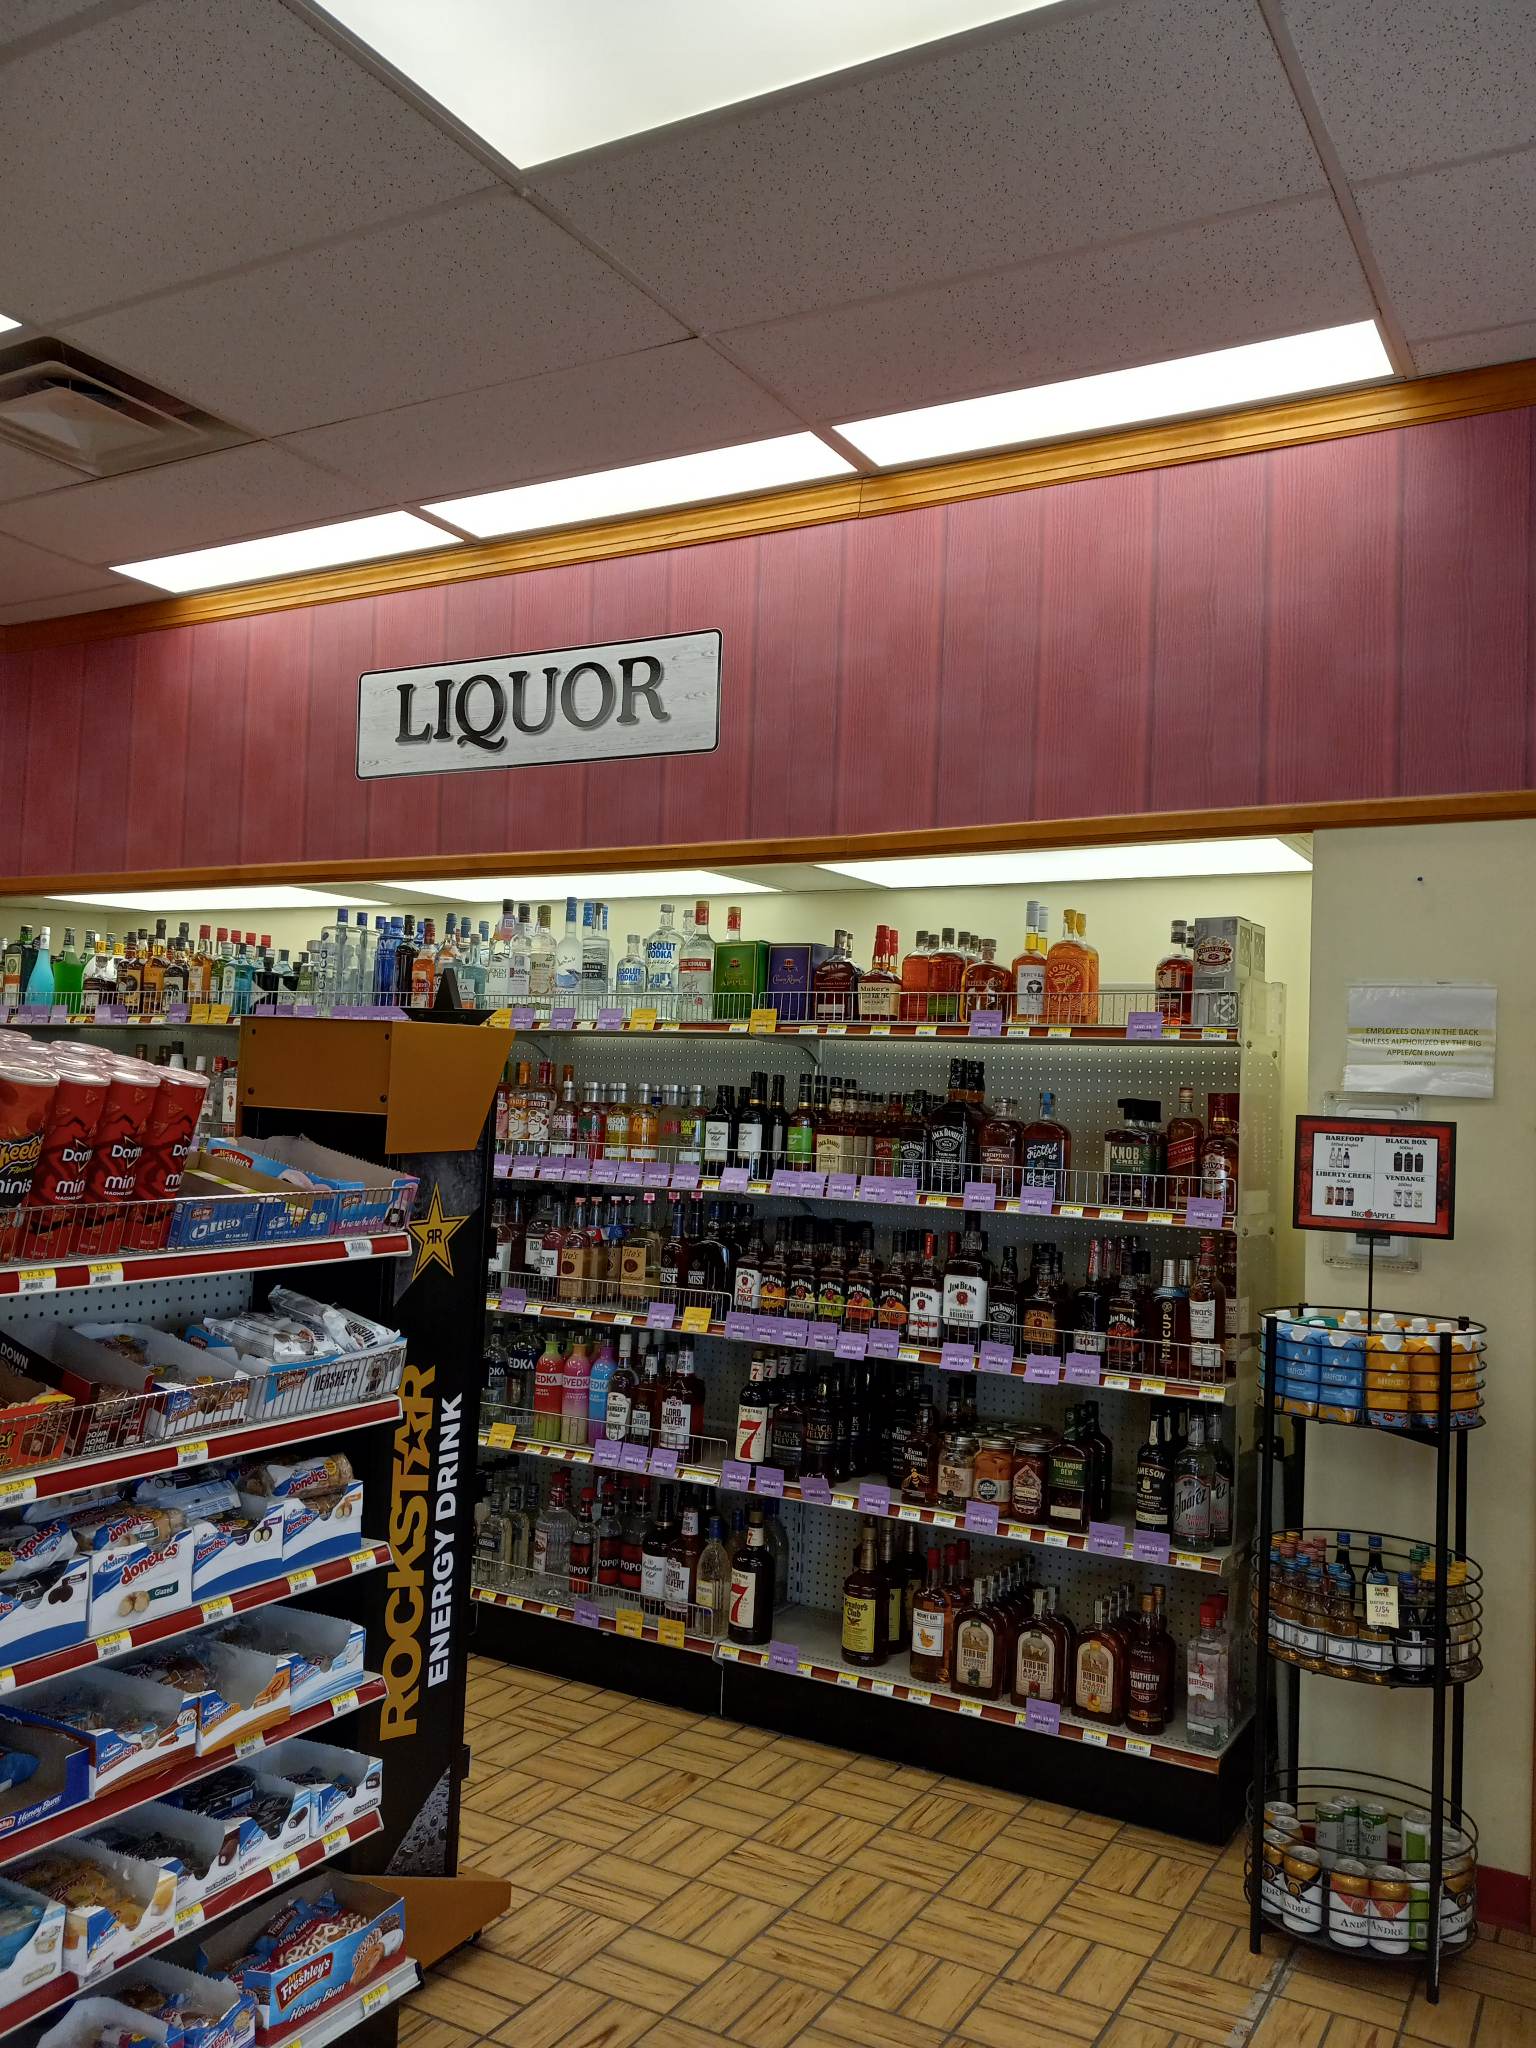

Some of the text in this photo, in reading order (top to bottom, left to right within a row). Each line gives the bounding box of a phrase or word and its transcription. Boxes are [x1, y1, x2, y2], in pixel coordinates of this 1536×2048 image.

[394, 655, 669, 751] LIQUOR
[1048, 962, 1082, 978] HOWLER
[1391, 1038, 1439, 1046] AUTHORIZED
[931, 1127, 944, 1141] JACK
[1111, 1146, 1140, 1160] KNOB
[190, 1218, 241, 1240] OREO
[623, 1248, 642, 1258] Tito's
[687, 1276, 705, 1286] MIST
[828, 1281, 842, 1293] BEAM
[889, 1287, 904, 1300] BEAM
[948, 1281, 977, 1296] JIM BEAM
[0, 1343, 29, 1368] DOWN
[751, 1367, 760, 1380] 7
[765, 1365, 773, 1377] 7
[313, 1367, 360, 1392] HERSHEY'S
[665, 1407, 681, 1417] LORD
[85, 1437, 107, 1445] HOME
[87, 1430, 109, 1439] DOWN
[739, 1420, 762, 1460] 7
[82, 1442, 117, 1454] DELIGHTS
[907, 1447, 923, 1456] Evan
[1053, 1458, 1083, 1471] TULLAMORE
[288, 1467, 328, 1494] donettes
[286, 1514, 313, 1534] donettes
[427, 1391, 463, 1689] ENERGY DRINK
[197, 1537, 228, 1560] donettes
[379, 1364, 436, 1741] ROCKSTAR
[154, 1585, 174, 1597] Glazed
[730, 1583, 748, 1623] 7
[846, 1608, 861, 1619] Club
[916, 1612, 929, 1620] MOUNT
[1023, 1659, 1036, 1669] BIRD
[1129, 1670, 1160, 1682] SOUTHERN
[1130, 1680, 1158, 1691] COMFORT
[281, 1958, 331, 2001] Freshley's
[289, 1998, 321, 2022] Honey
